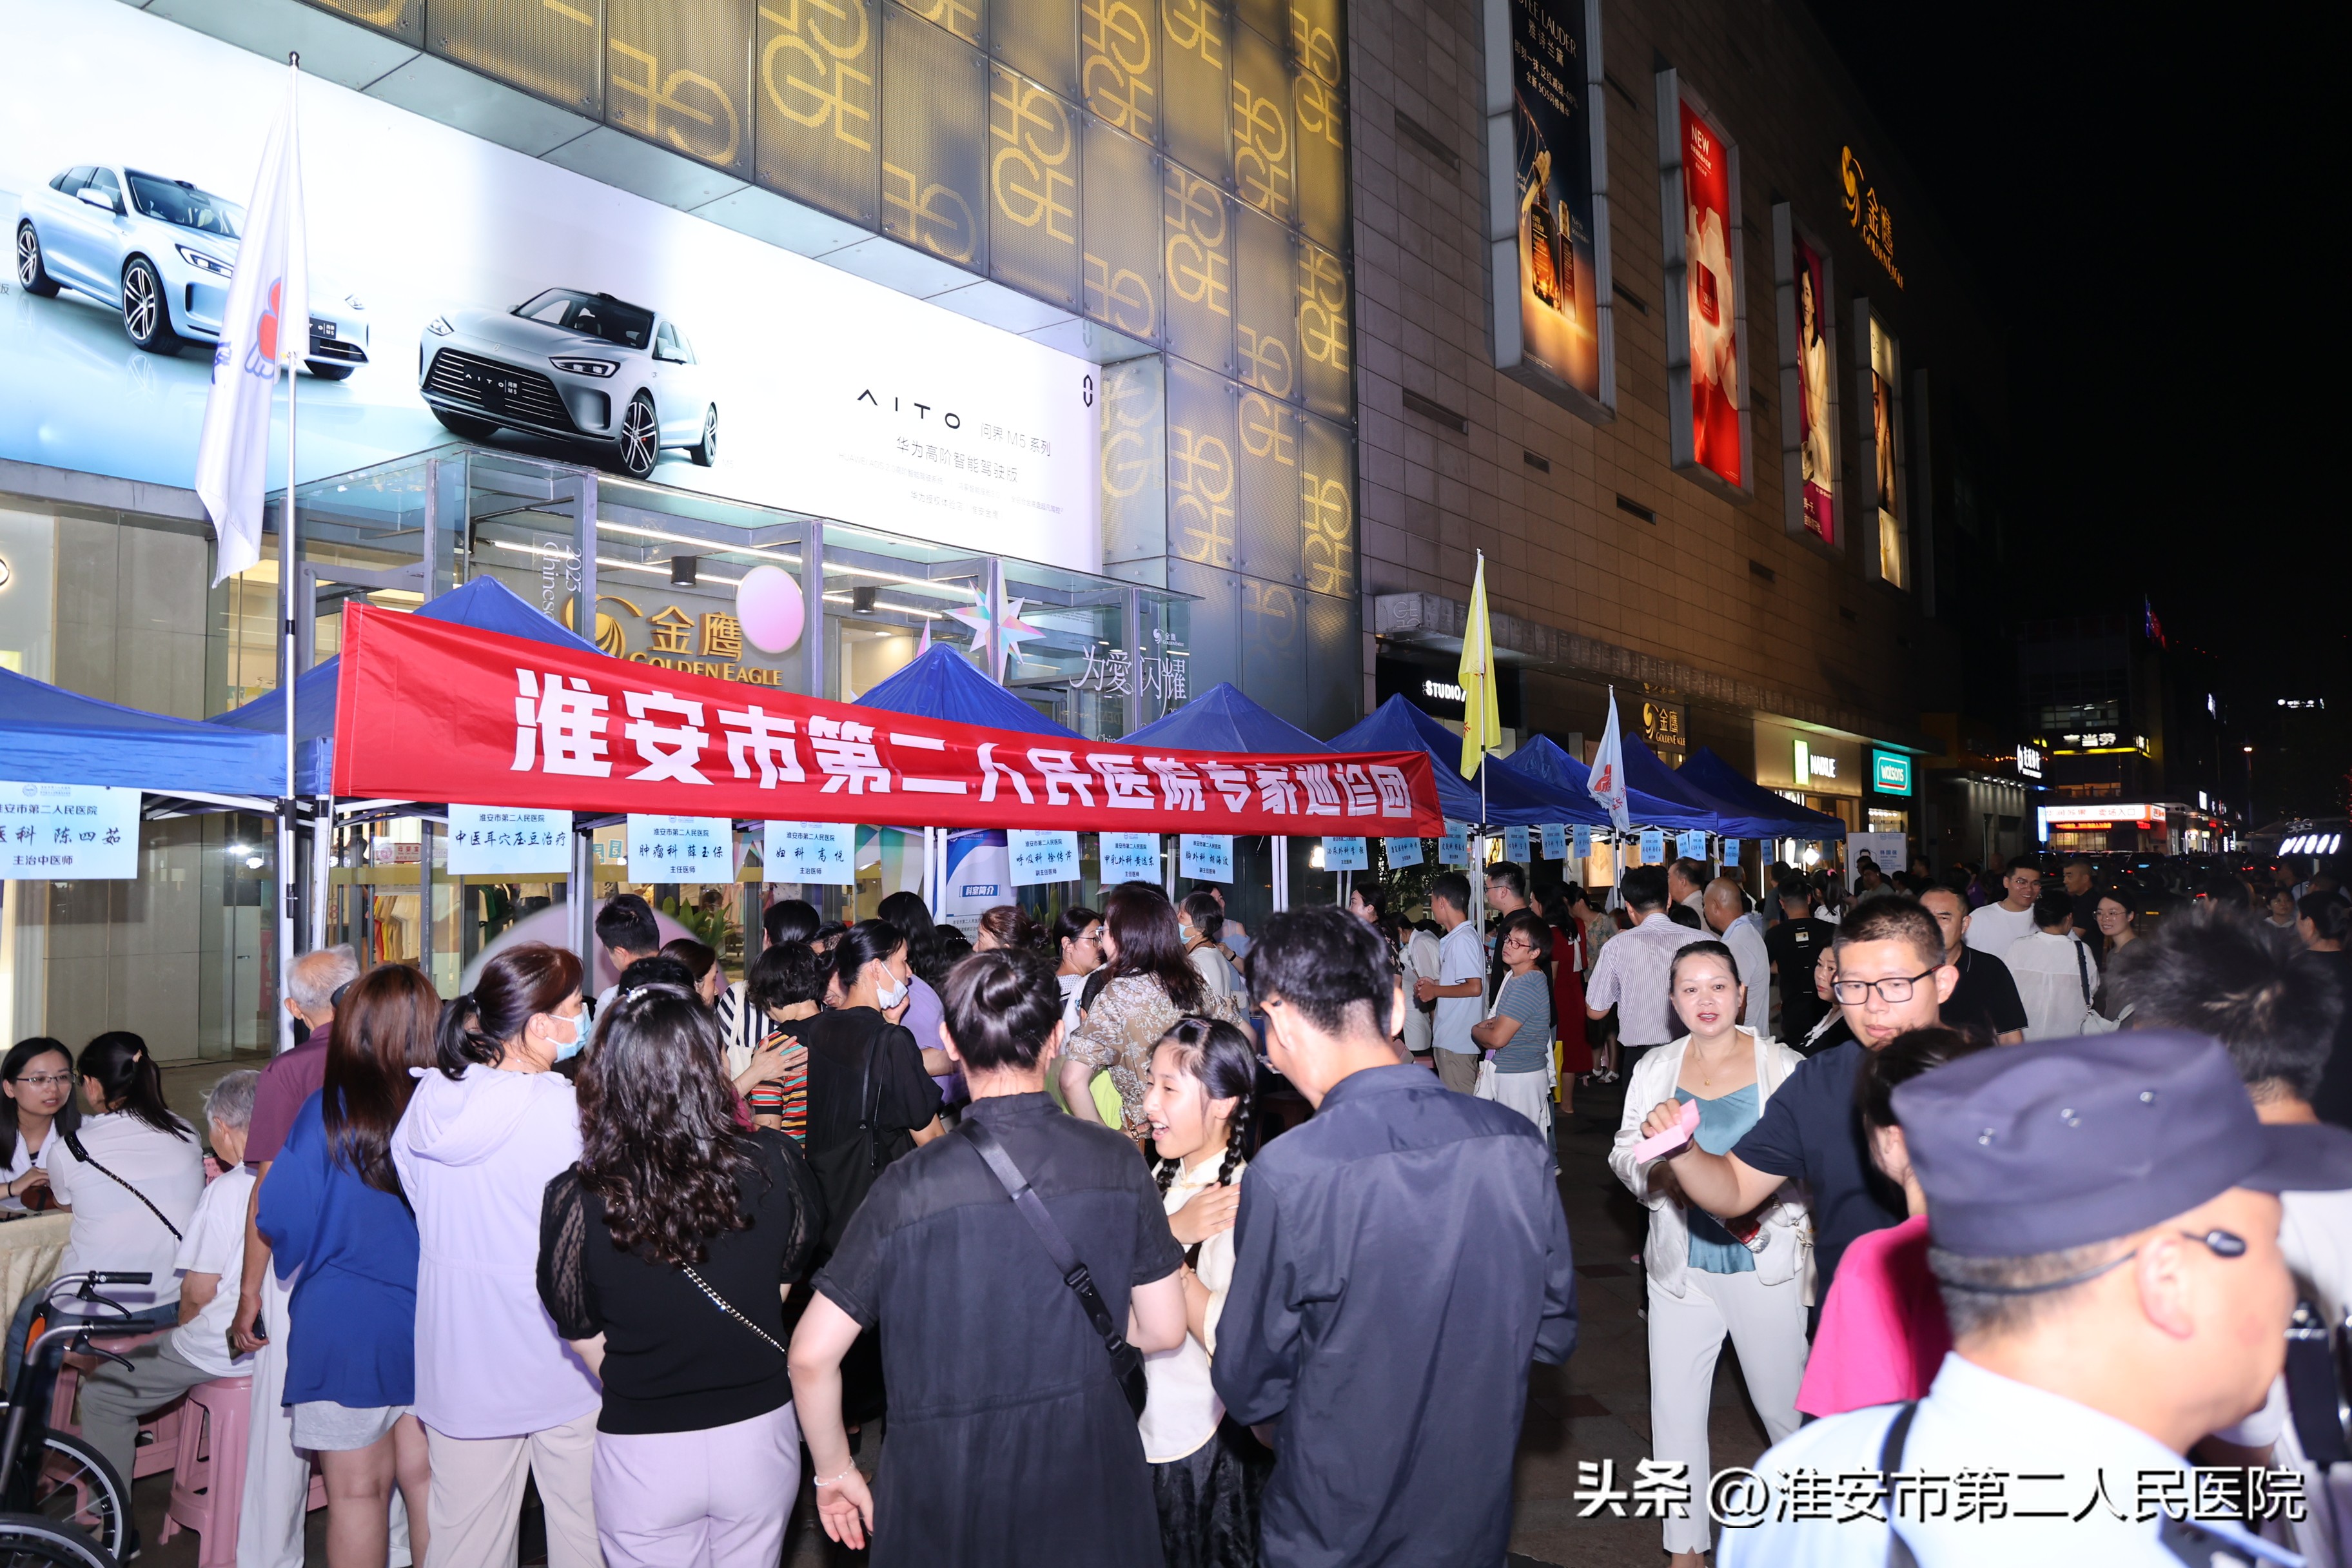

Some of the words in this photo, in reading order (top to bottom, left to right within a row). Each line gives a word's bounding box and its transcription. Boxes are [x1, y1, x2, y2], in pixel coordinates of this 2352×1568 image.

[1542, 9, 1577, 58] LAUDER
[1691, 123, 1709, 155] NEW
[857, 389, 961, 429] AITO
[980, 422, 1004, 442] 问界
[1007, 430, 1026, 449] M5
[1030, 437, 1052, 457] 系列
[896, 435, 1019, 484] 华为高阶智能驾驶版
[565, 544, 582, 593] 2023
[646, 605, 743, 663] 金鹰
[723, 662, 783, 686] EAGLE
[1659, 708, 1679, 734] 金鹰
[510, 667, 1413, 818] 淮安市第二人民医院专家巡诊团
[1881, 765, 1904, 782] watsons
[479, 814, 545, 823] 淮安市第二人民医院
[2099, 808, 2136, 817] 卖场入口
[455, 830, 566, 848] 中医耳穴压豆治疗
[653, 828, 709, 837] 淮安市第二人民医院
[786, 832, 836, 842] 淮安市第二人民医院
[639, 843, 678, 859] 肿瘤科
[687, 844, 723, 859] 薛玉保
[1024, 839, 1063, 847] 淮安市第二人民医院
[1193, 840, 1222, 850] 淮安市第二人民医院
[12, 856, 74, 866] 主治中医师
[1016, 852, 1043, 866] 呼吸科
[1185, 850, 1206, 863] 胸外科
[1035, 868, 1057, 877] 副主任医师
[965, 885, 995, 896] 科室简介
